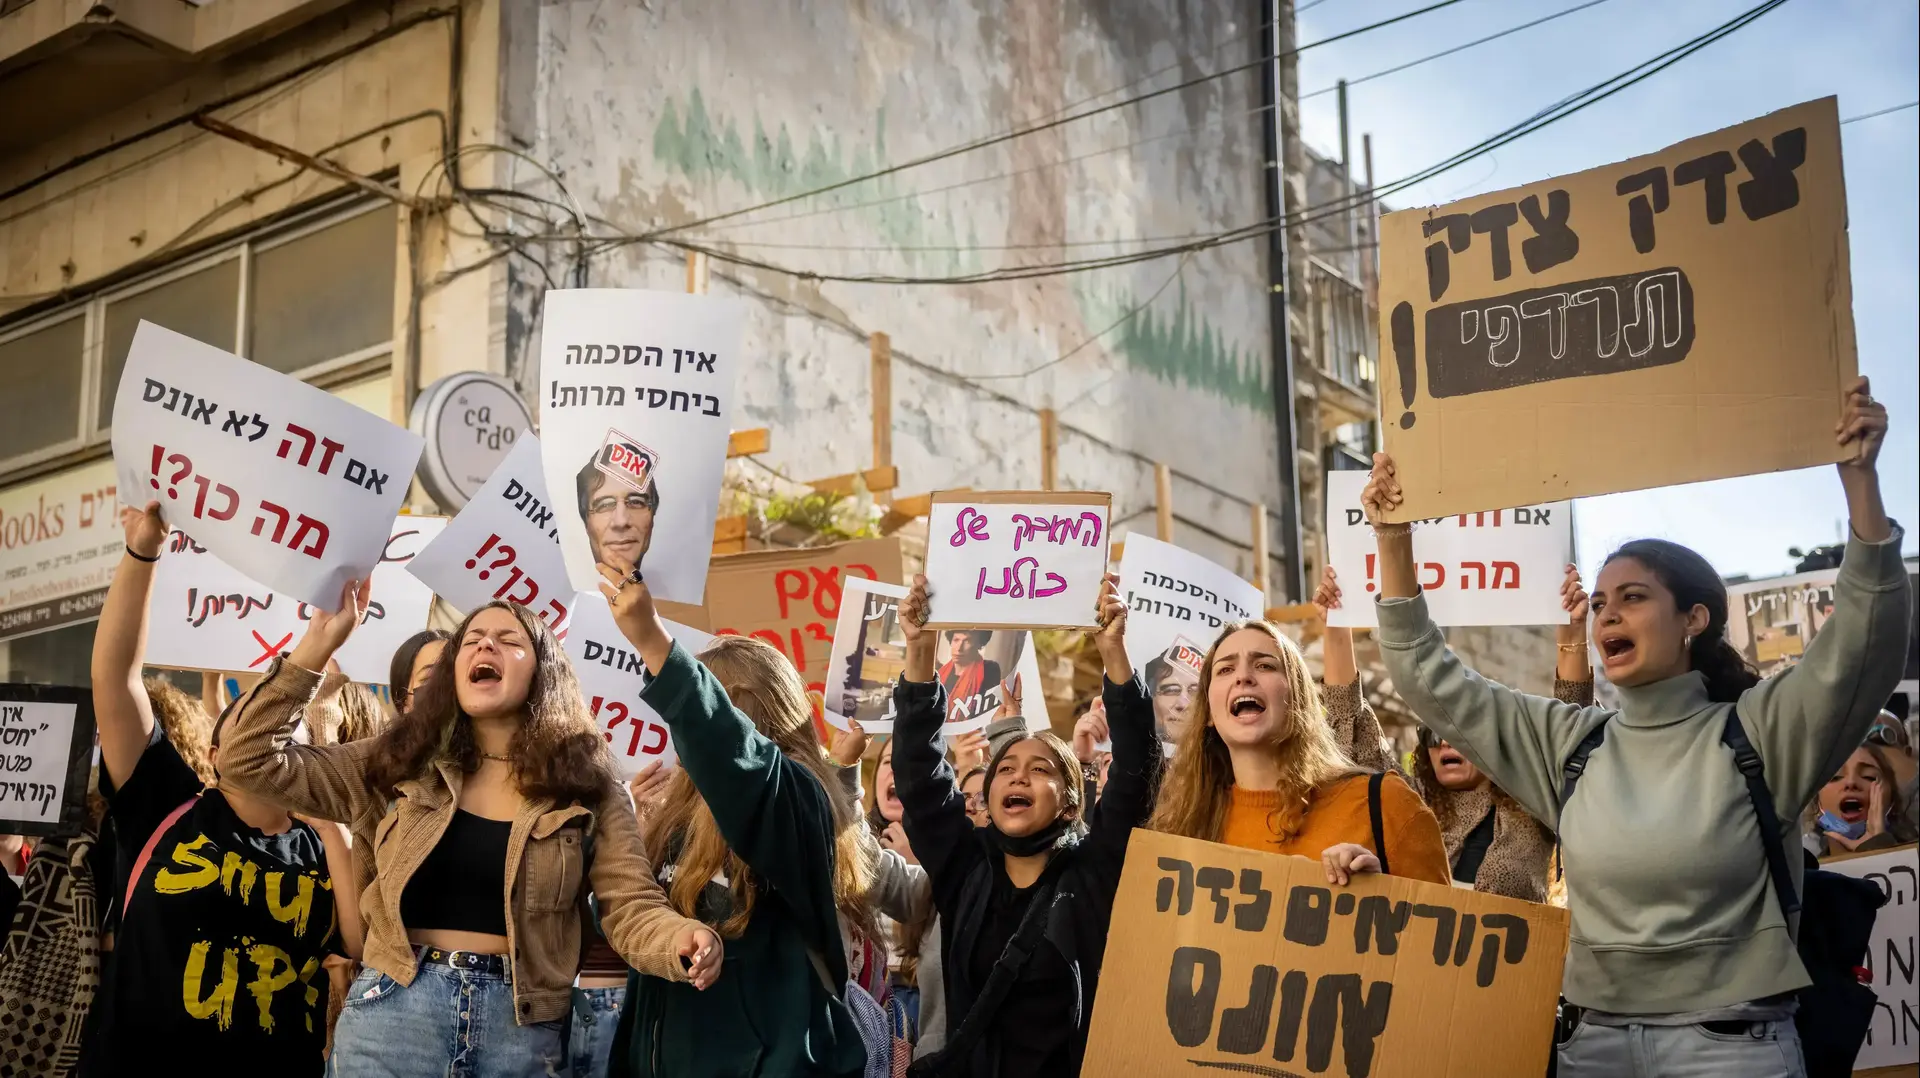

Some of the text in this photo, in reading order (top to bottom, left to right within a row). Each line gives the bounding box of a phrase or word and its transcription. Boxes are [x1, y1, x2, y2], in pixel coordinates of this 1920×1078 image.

[1423, 127, 1807, 302] צדק צדק
[1460, 271, 1681, 368] תרדפי
[565, 344, 717, 374] אין הסכמה
[551, 380, 721, 417] ביחסי מרות!
[142, 377, 389, 495] אם זה לא אונס
[610, 443, 647, 477] אנס
[149, 444, 241, 522] כן?!
[502, 478, 554, 530] אונס
[0, 493, 65, 550] ooks
[78, 485, 118, 529] רים
[949, 507, 1102, 551] המאבק של
[1514, 507, 1552, 526] אם
[250, 500, 331, 560] מה
[975, 556, 1068, 600] כולנו
[1142, 571, 1218, 605] הסכמה
[1461, 560, 1521, 590] מה
[1127, 591, 1192, 621] מרות!
[1747, 592, 1787, 617] ידע
[583, 639, 644, 676] אונס
[2, 706, 24, 727] אין
[949, 684, 1003, 720] הוא
[1283, 885, 1529, 988] קוראים
[1165, 946, 1393, 1078] אונס
